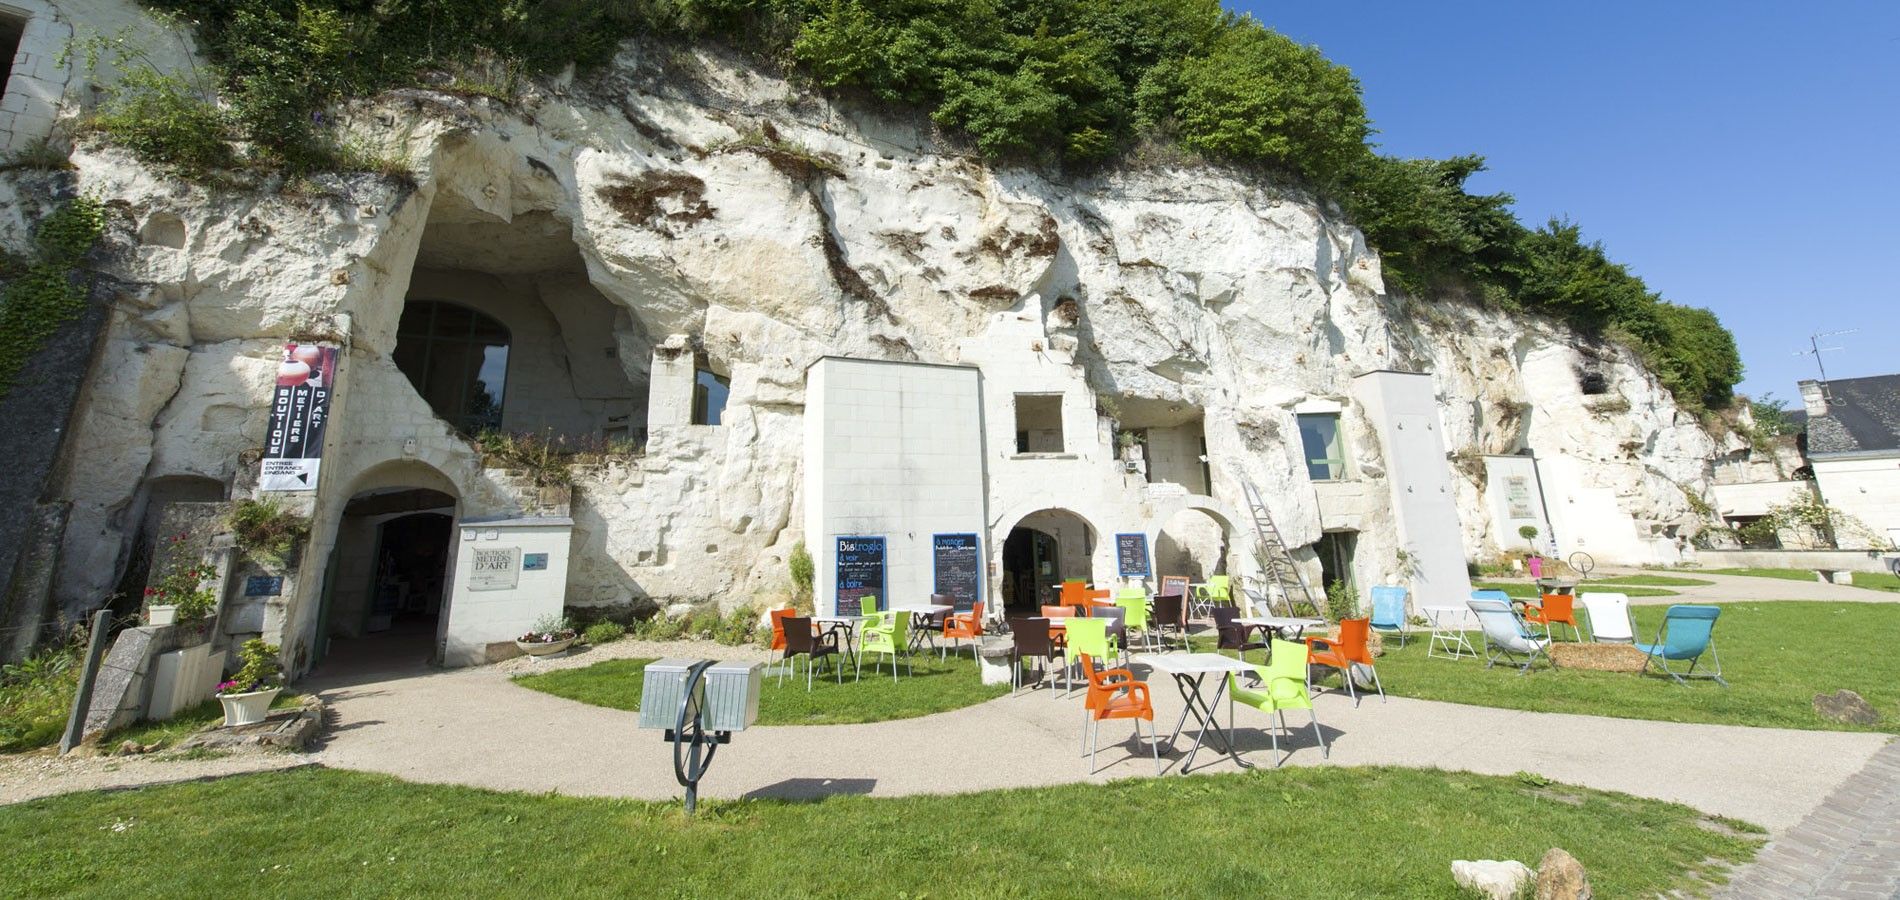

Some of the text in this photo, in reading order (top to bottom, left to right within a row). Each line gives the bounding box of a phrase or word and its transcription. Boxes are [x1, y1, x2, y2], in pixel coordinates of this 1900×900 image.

[270, 389, 289, 454] BOUTIQUE
[290, 389, 308, 443] METIERS
[312, 391, 326, 428] D'ART
[475, 562, 509, 570] D'ART
[839, 540, 883, 555] Bistroglo
